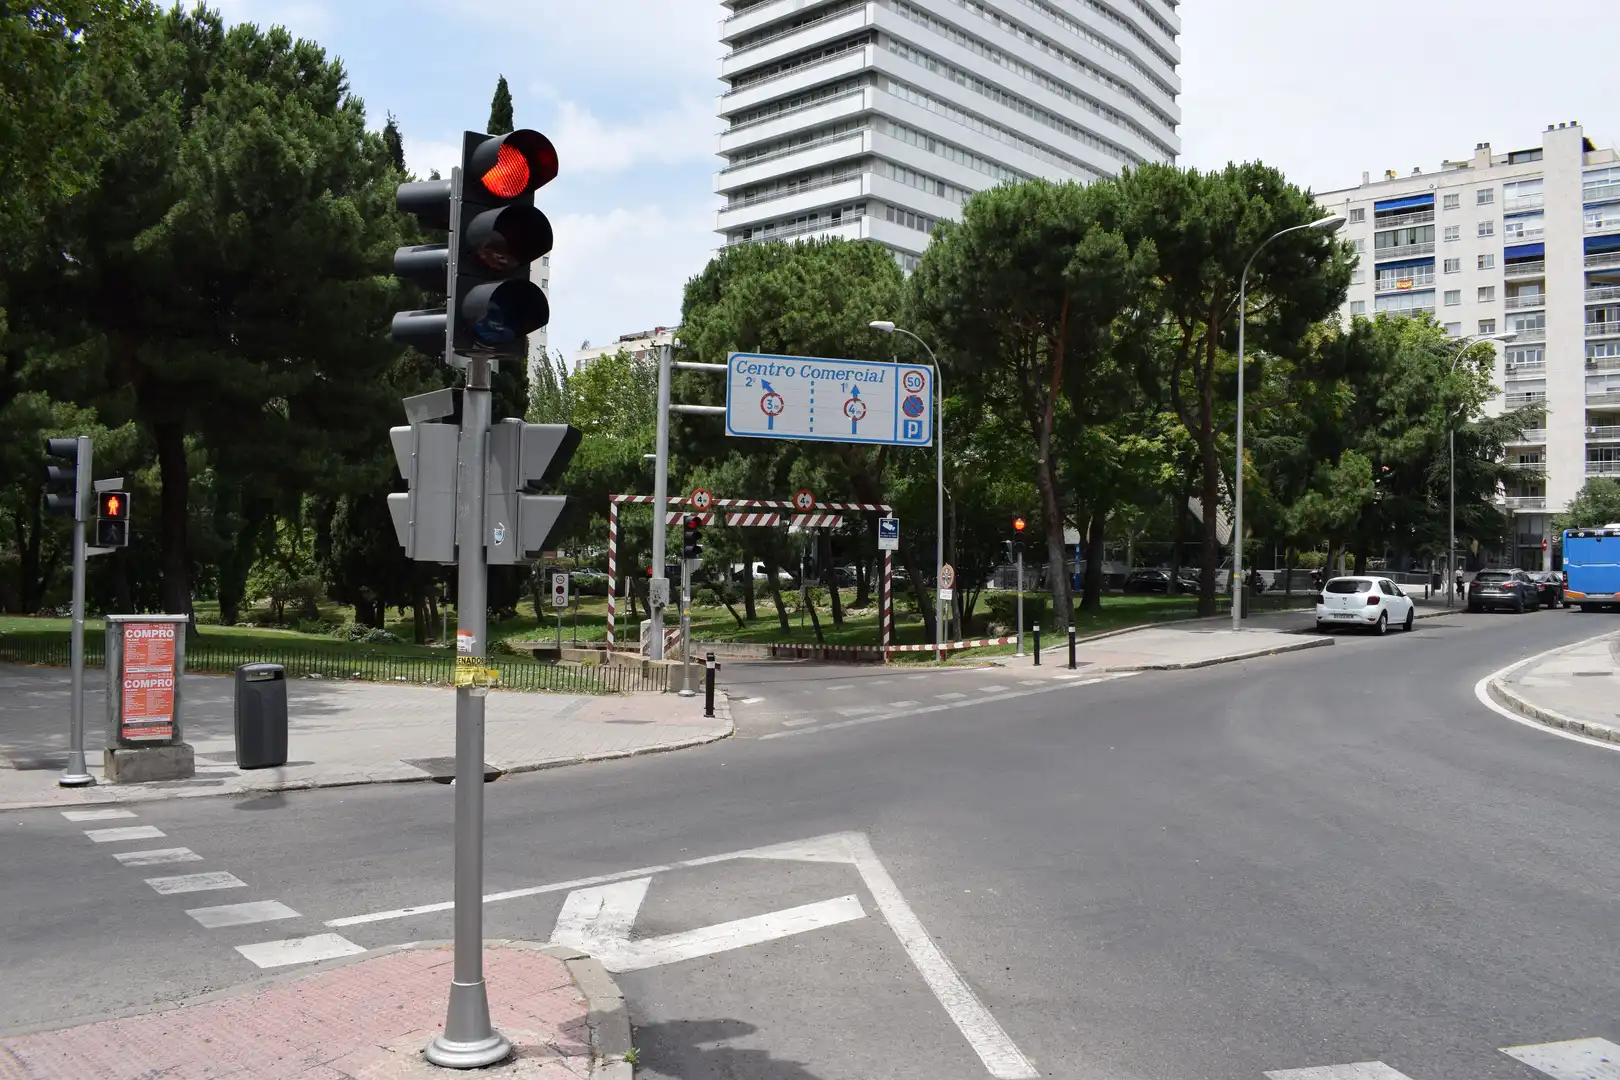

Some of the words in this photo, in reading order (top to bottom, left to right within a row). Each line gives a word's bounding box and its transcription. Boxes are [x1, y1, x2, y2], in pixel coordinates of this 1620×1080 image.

[736, 360, 795, 378] Centro
[800, 364, 885, 383] Comercial
[907, 376, 921, 388] 50
[907, 421, 919, 438] P
[125, 629, 174, 638] COMPRO
[124, 679, 173, 689] COMPRO
